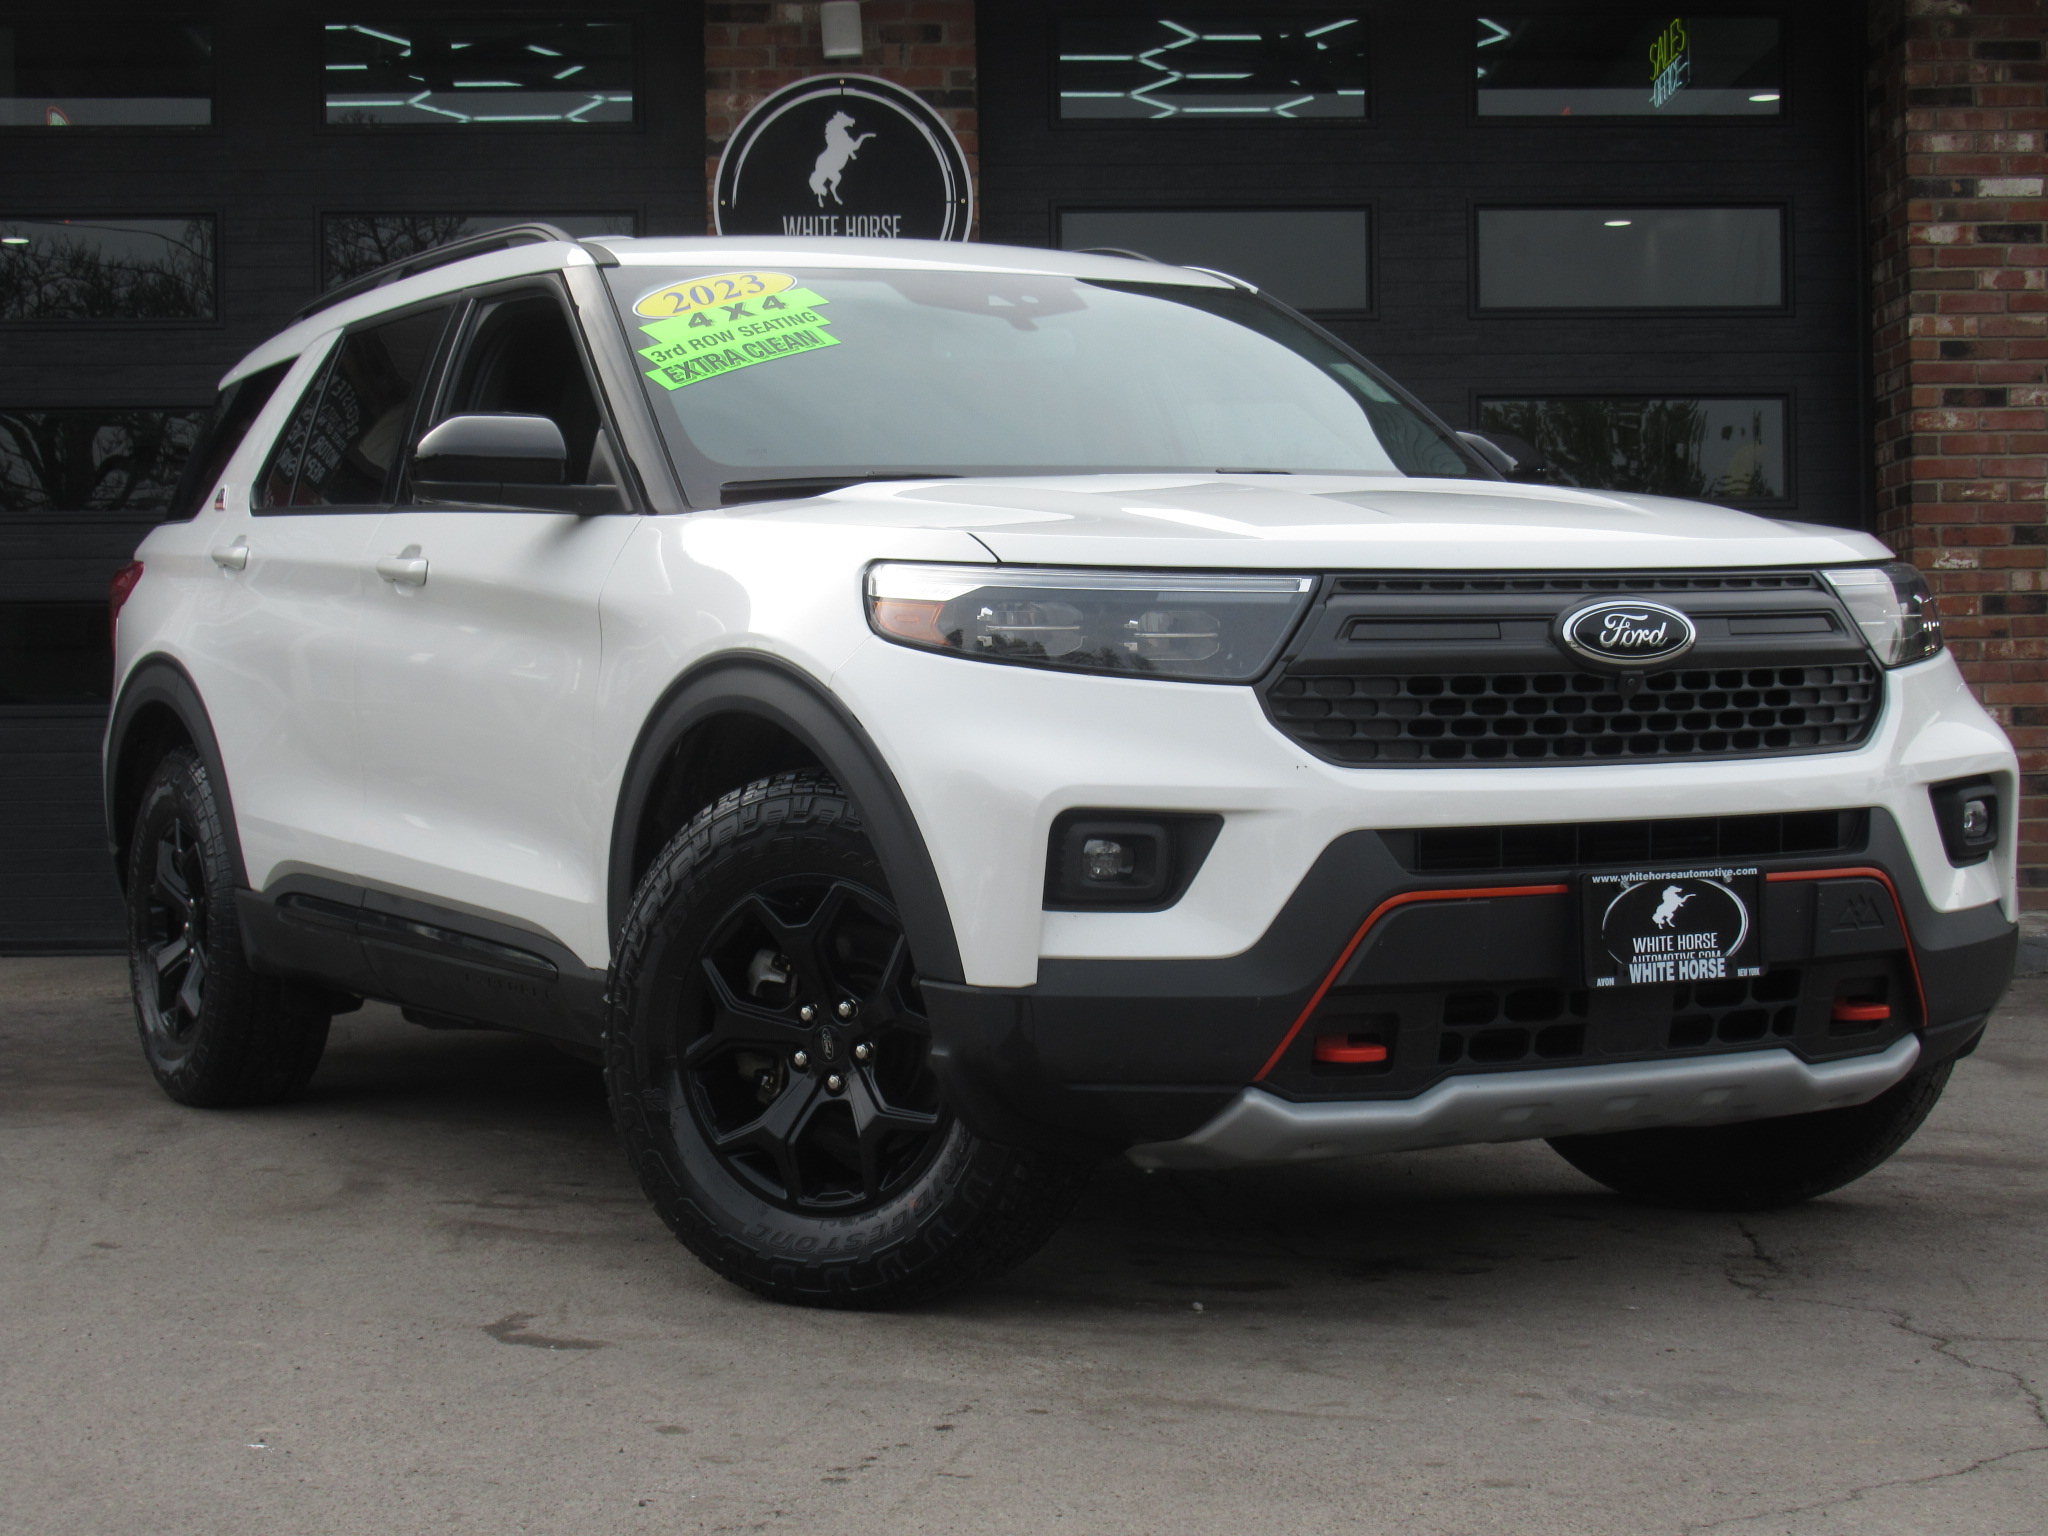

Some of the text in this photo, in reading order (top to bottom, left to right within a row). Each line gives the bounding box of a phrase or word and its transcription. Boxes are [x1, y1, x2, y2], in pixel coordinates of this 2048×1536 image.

[1649, 18, 1687, 81] SALES
[783, 215, 902, 239] WHITE HORSE
[663, 274, 766, 314] 2023
[650, 311, 819, 363] 3rd ROW SEATING
[662, 330, 826, 384] EXTRA CLEAN
[1599, 613, 1668, 648] Ford
[1592, 867, 1758, 884] www.whitehorseautomotive.com
[1633, 932, 1718, 953] WHITE HORSE
[1596, 977, 1615, 987] AVON
[1629, 957, 1726, 984] WHITE HORSE
[1748, 967, 1760, 976] YORK
